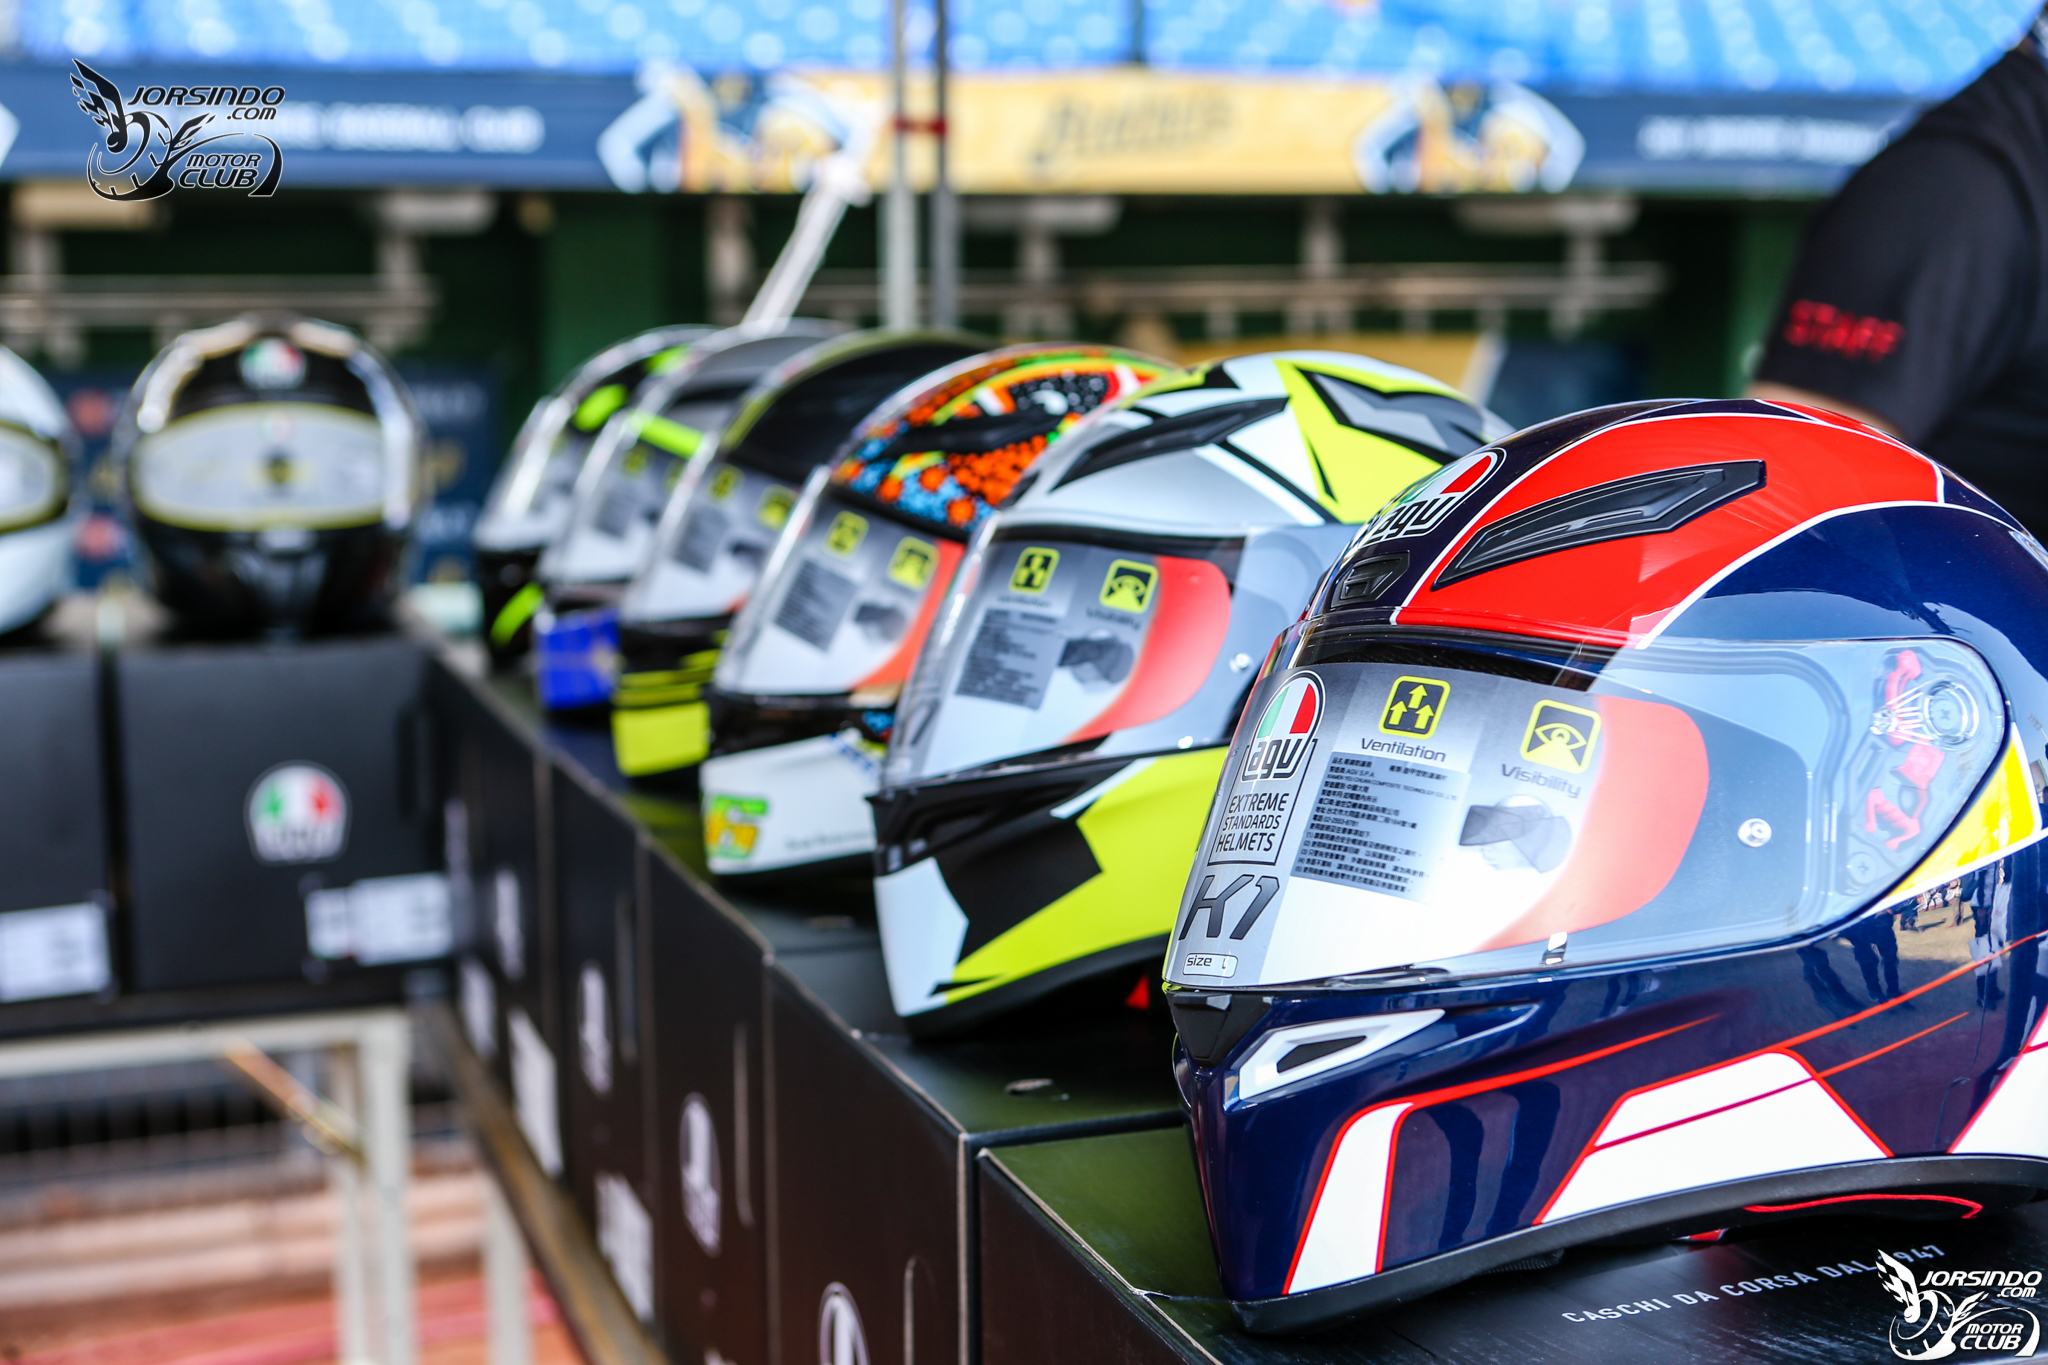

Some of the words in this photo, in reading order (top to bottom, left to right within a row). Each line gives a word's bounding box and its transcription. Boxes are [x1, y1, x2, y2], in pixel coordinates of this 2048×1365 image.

[1785, 300, 1905, 361] STAFF
[1361, 737, 1447, 763] Ventilation
[1501, 762, 1582, 799] Visibility
[1228, 793, 1290, 814] EXTREME
[1223, 814, 1282, 832] STANDARDS
[1215, 832, 1276, 853] HELMETS
[1178, 873, 1280, 941] K1
[1186, 955, 1212, 967] size
[1561, 1297, 1673, 1325] CASCHI
[1673, 1289, 1720, 1307] DA
[1719, 1270, 1819, 1298] CORSA
[1816, 1258, 1878, 1279] DAL
[1877, 1244, 1946, 1263] 947
